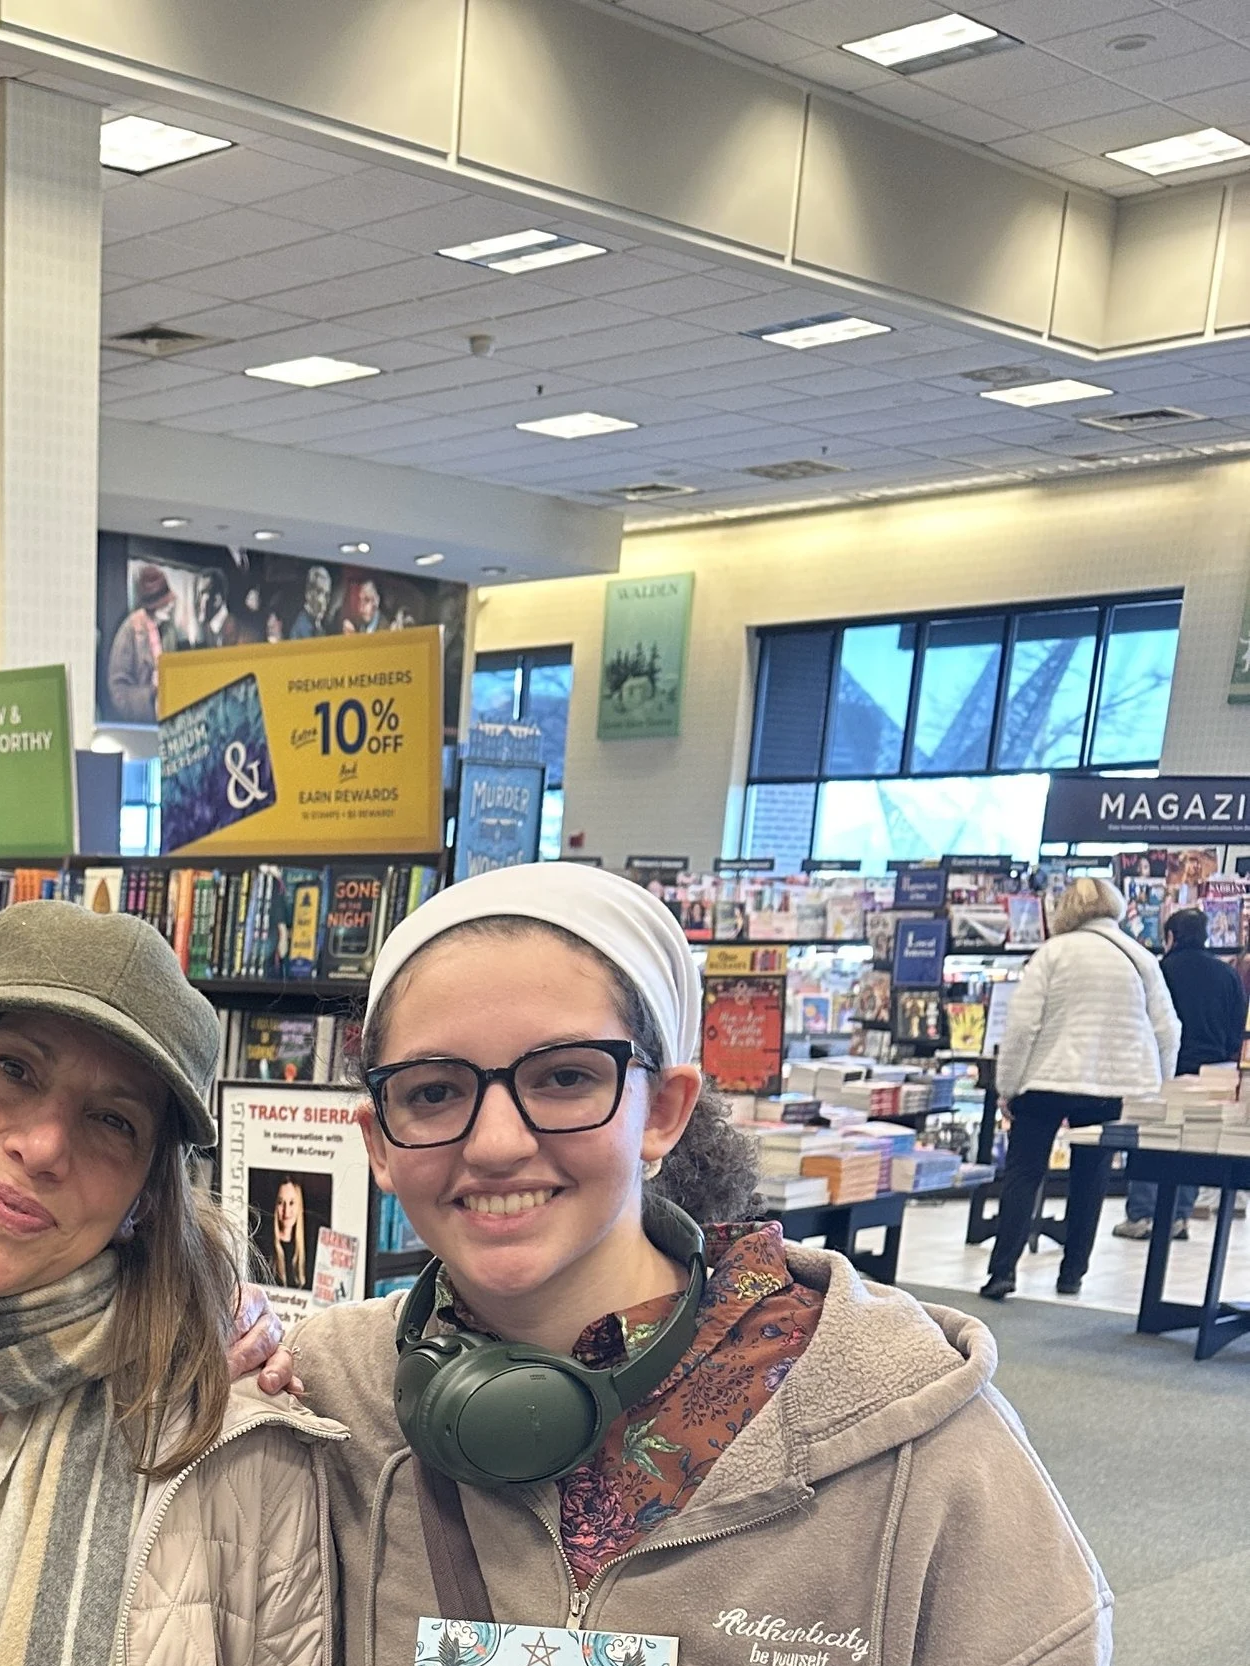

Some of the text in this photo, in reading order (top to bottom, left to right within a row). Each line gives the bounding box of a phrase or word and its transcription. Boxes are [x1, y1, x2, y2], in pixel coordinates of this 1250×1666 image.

[616, 582, 679, 601] WALDEN
[287, 670, 412, 693] PREMIUM MEMBERS
[10, 704, 22, 725] &
[367, 734, 404, 754] OFF
[298, 787, 399, 804] EARN REWARDS
[470, 780, 530, 818] MURDER
[1100, 792, 1247, 821] MAGAZI
[335, 880, 381, 899] GONE
[327, 911, 374, 929] NIGHT
[248, 1104, 360, 1126] TRACY SIERRA
[273, 1131, 324, 1142] conversation
[326, 1134, 344, 1143] with
[271, 1145, 295, 1157] Marcy
[712, 1607, 871, 1661] Authenticity
[750, 1642, 769, 1665] be
